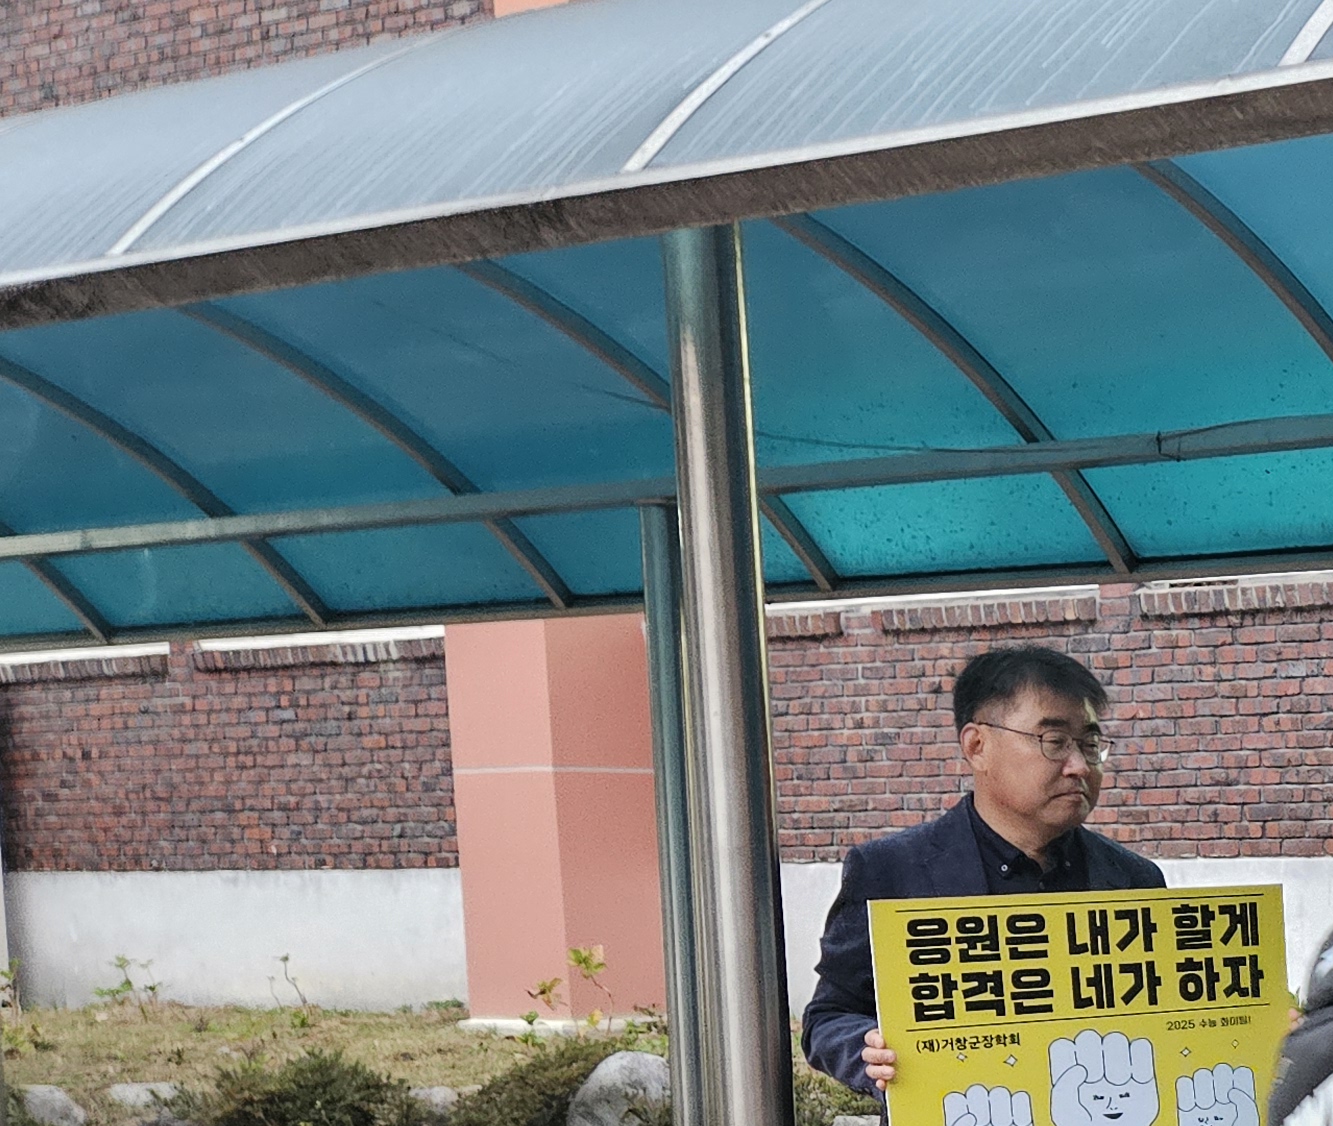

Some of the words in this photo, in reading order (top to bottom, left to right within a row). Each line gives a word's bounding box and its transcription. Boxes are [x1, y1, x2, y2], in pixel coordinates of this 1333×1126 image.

[905, 912, 1050, 966] 응원은
[1066, 907, 1158, 956] 내가
[1171, 902, 1260, 951] 할게
[908, 967, 1054, 1022] 합격은
[1070, 960, 1163, 1010] 네가
[1175, 954, 1264, 1001] 하자
[916, 1032, 1021, 1054] (재)거창군장학회
[1166, 1019, 1196, 1031] 2025
[1199, 1018, 1217, 1028] 수능
